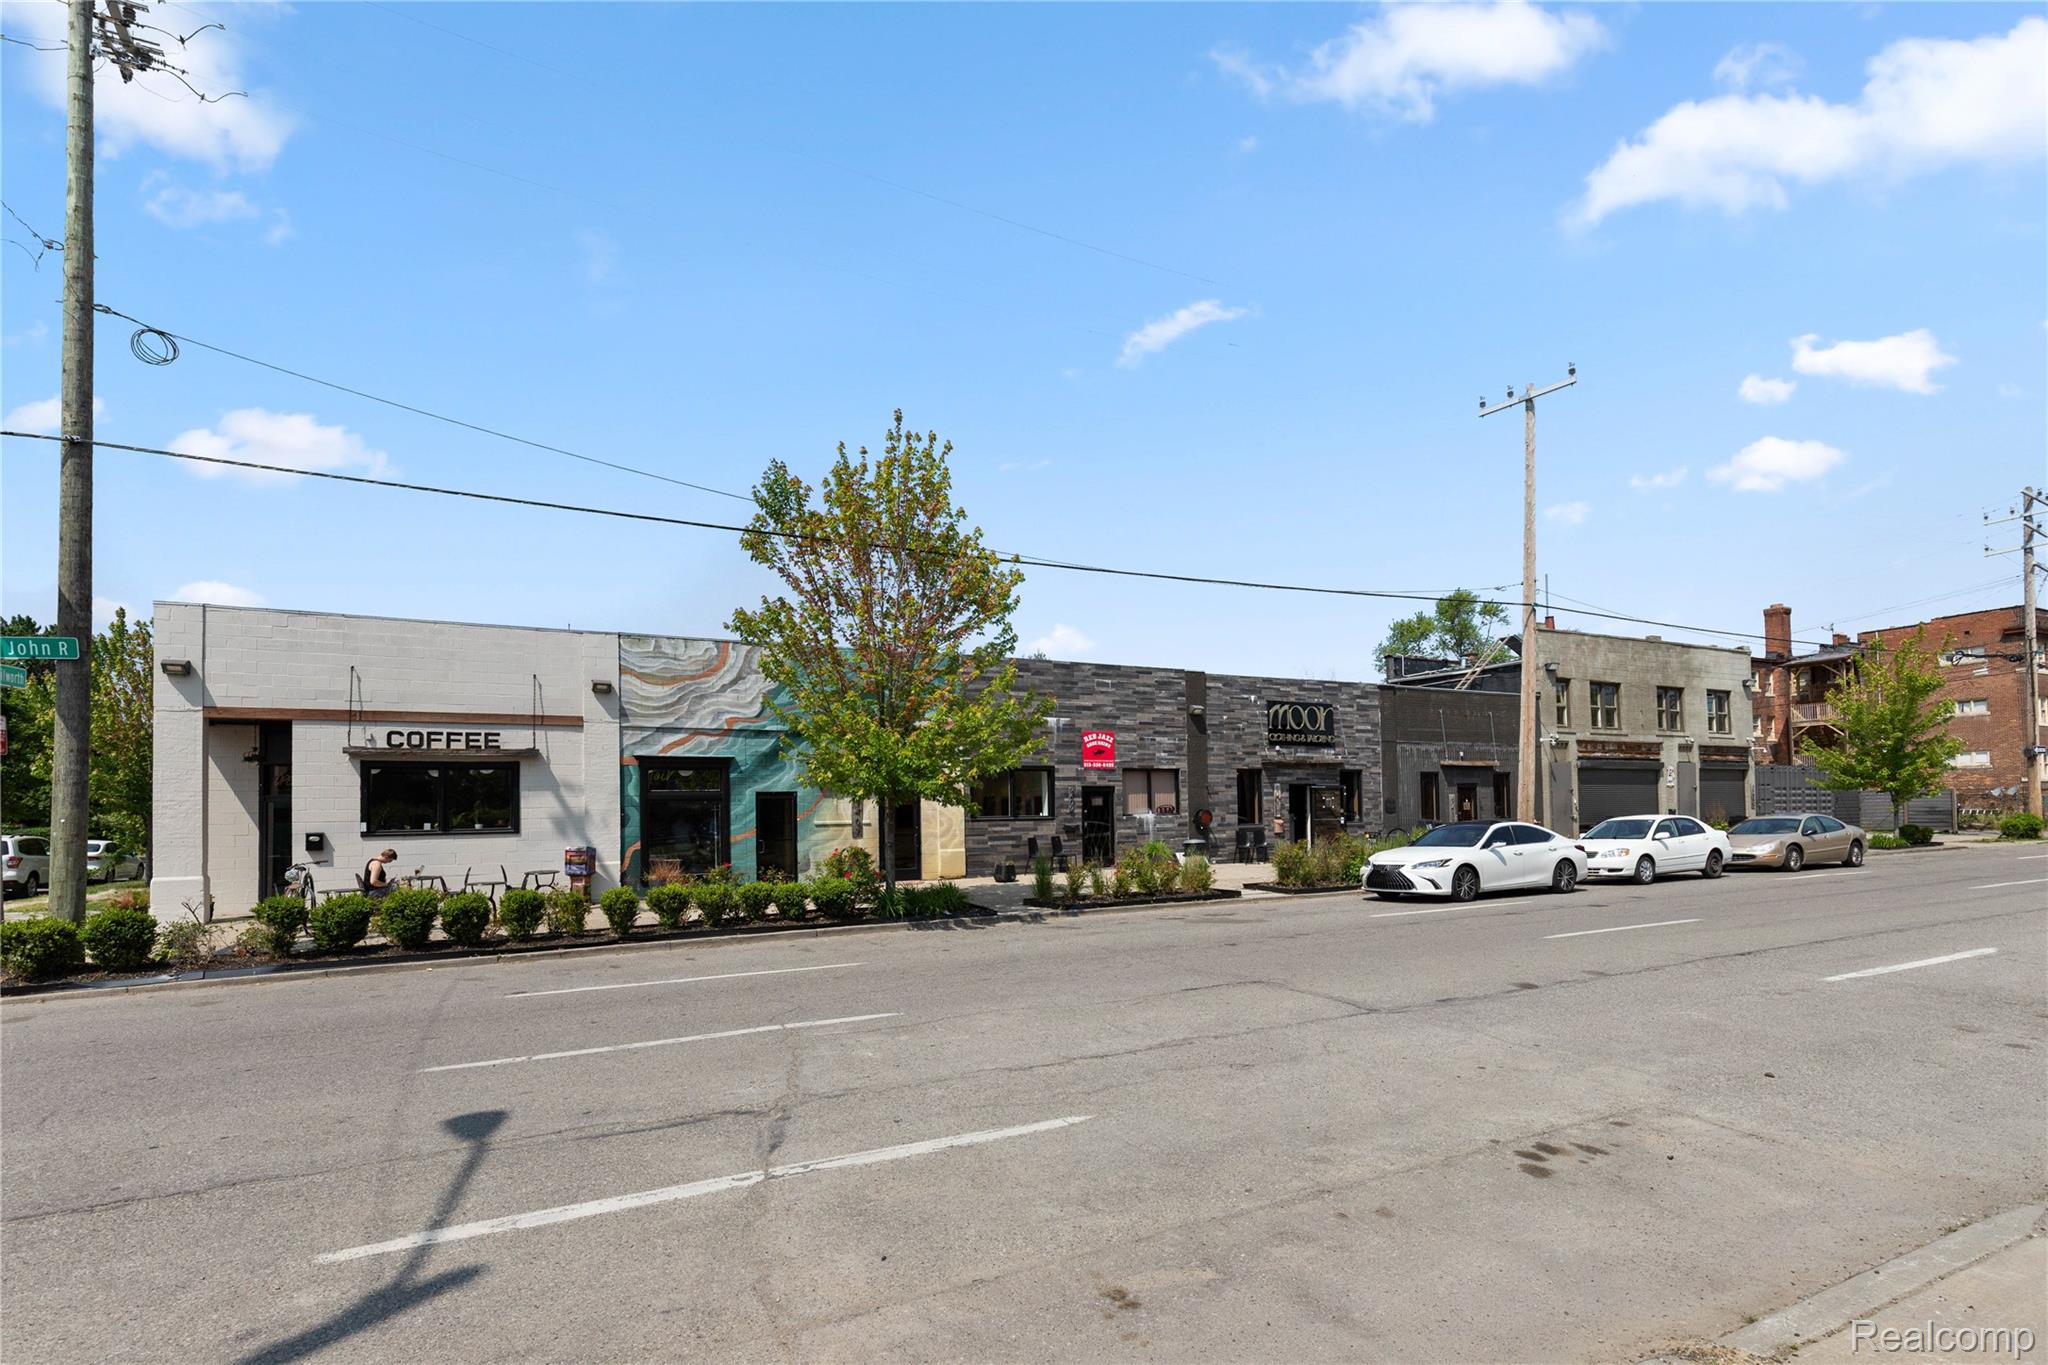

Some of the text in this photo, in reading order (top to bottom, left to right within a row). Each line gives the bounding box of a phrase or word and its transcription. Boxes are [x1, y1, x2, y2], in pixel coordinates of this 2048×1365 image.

[8, 640, 68, 656] John R
[386, 731, 501, 750] COFFEE
[1083, 733, 1114, 743] RED JAZZ
